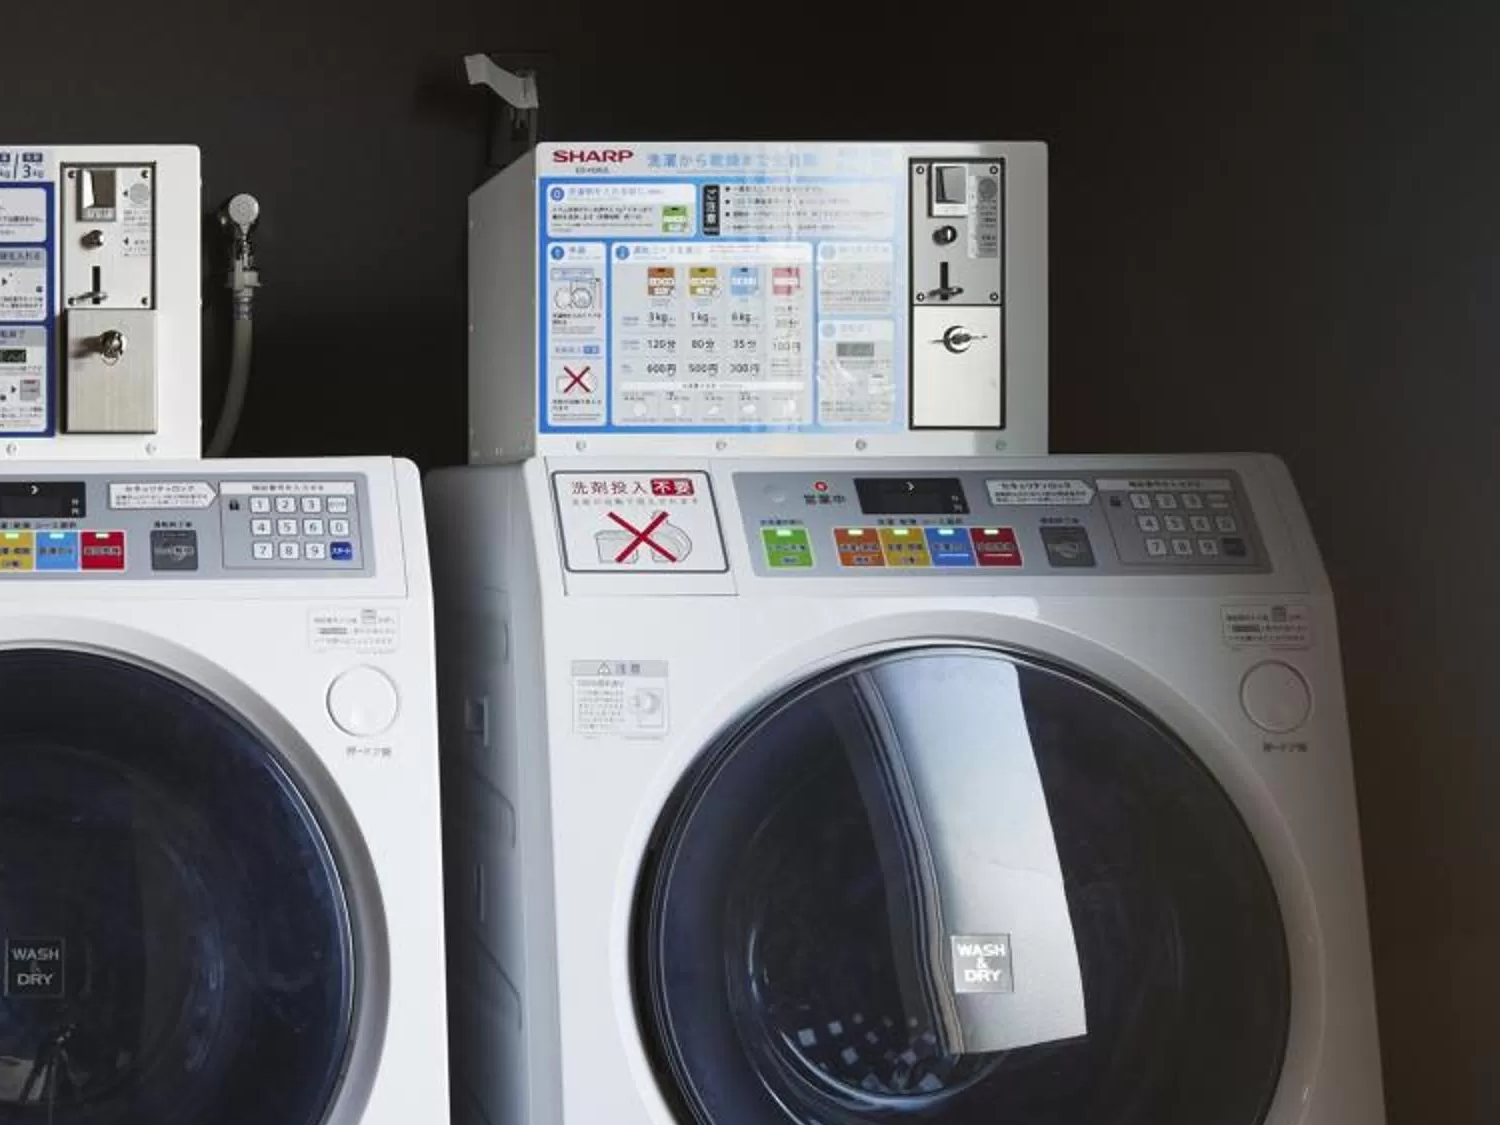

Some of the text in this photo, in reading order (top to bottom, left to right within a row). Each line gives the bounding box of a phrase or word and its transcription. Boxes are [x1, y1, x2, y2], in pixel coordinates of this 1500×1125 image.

[553, 150, 634, 163] SHARP
[12, 948, 59, 960] WASH
[956, 943, 1006, 957] WASH
[17, 973, 53, 985] DRY
[964, 969, 1002, 982] DRY
